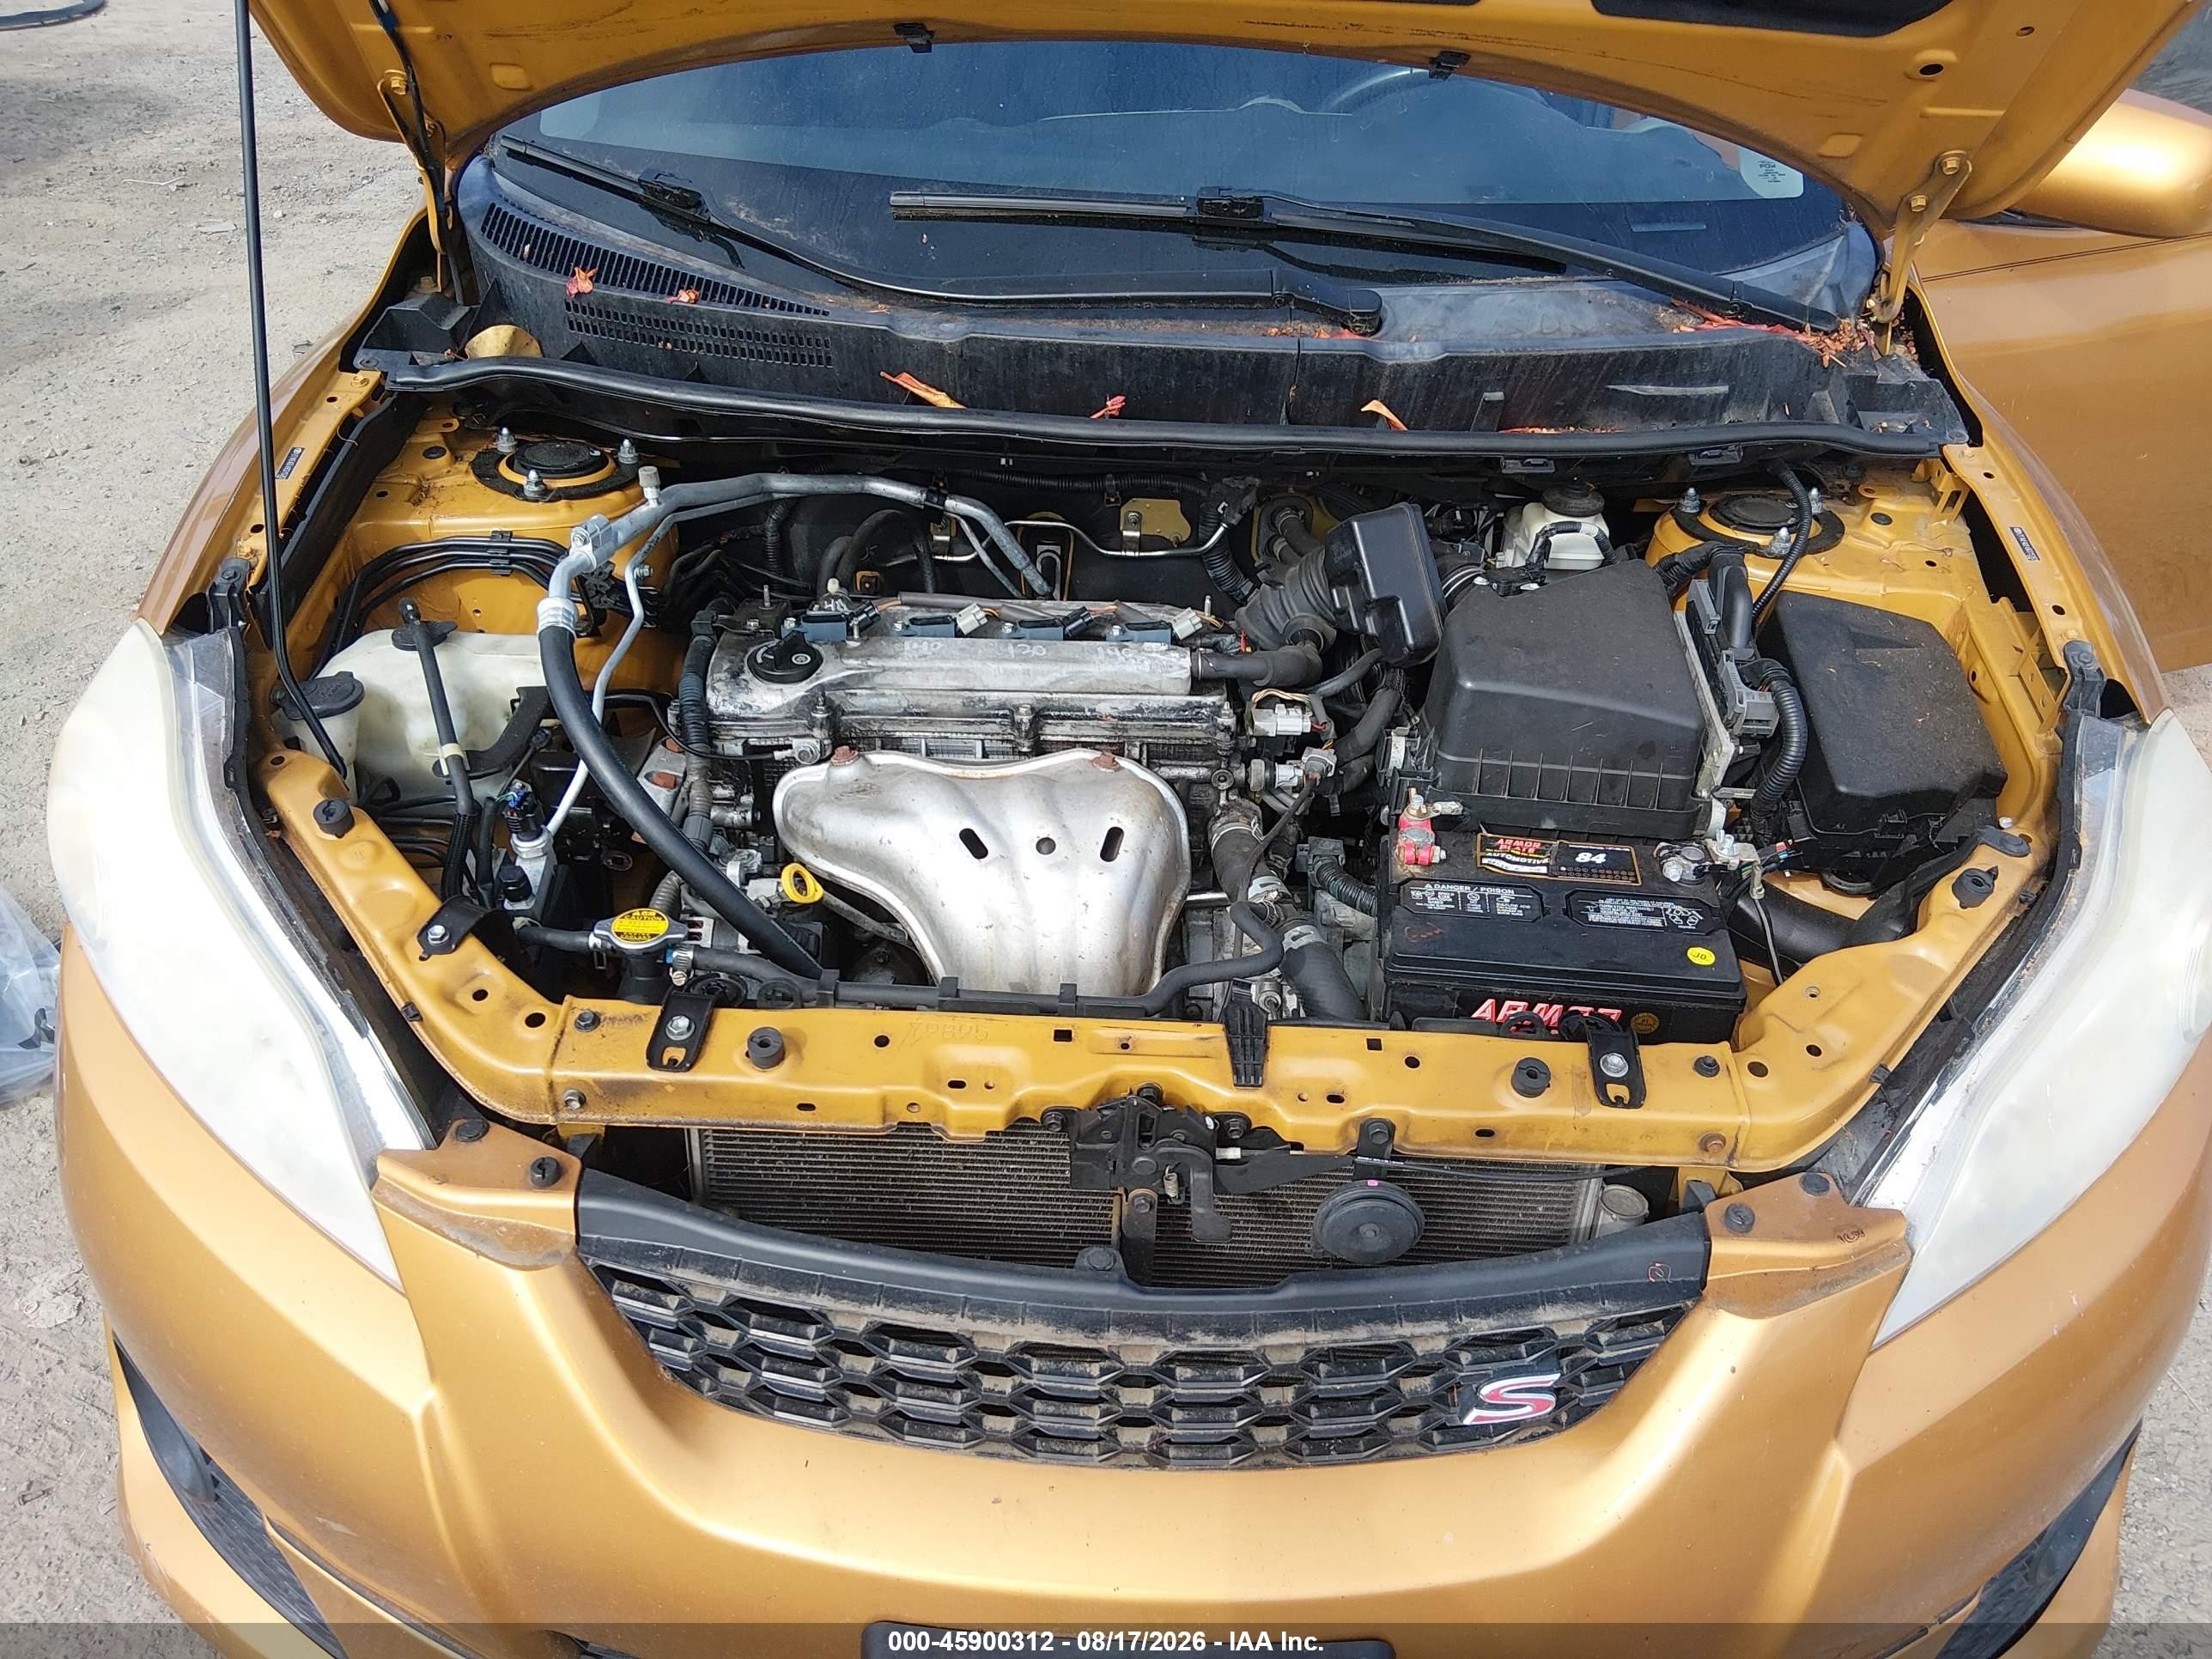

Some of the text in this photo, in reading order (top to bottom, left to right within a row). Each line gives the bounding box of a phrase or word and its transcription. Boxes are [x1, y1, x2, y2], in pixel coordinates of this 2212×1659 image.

[1498, 838, 1541, 848] ARMOR
[1575, 852, 1607, 864] 84
[1480, 886, 1515, 895] POISON
[1462, 1373, 1561, 1425] S
